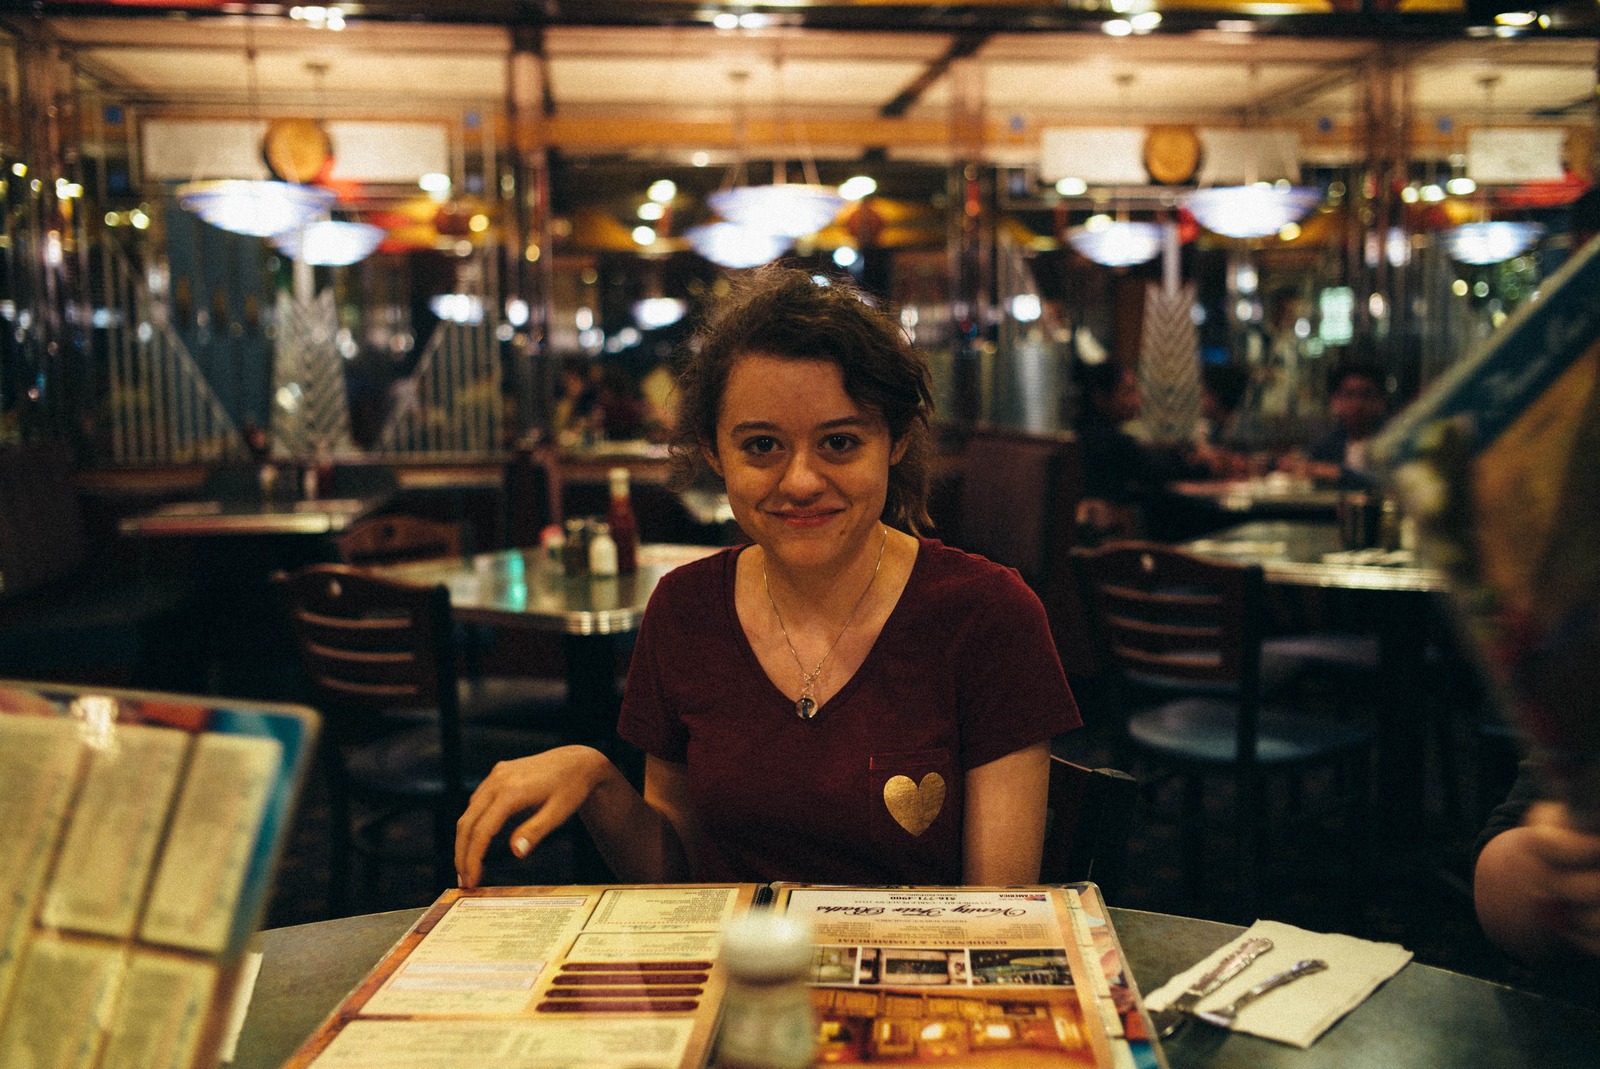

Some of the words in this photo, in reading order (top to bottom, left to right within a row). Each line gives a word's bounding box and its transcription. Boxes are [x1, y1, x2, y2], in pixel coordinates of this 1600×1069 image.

[816, 906, 885, 917] Baths
[892, 907, 945, 917] Fair
[951, 905, 1027, 918] Vanity
